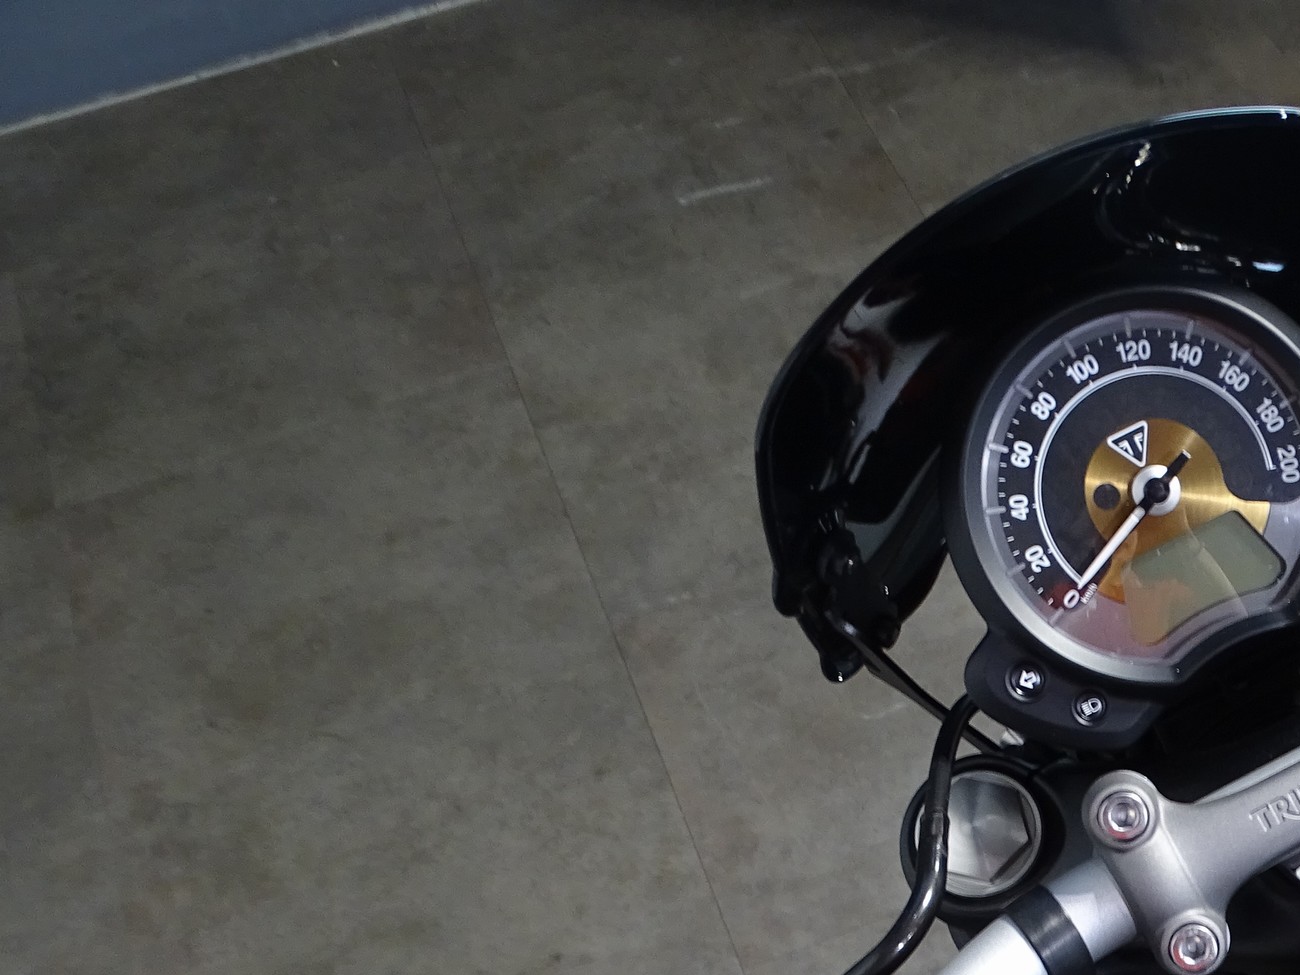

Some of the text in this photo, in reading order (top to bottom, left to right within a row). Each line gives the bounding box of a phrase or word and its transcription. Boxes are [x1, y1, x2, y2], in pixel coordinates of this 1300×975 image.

[1116, 339, 1151, 363] 120
[1169, 341, 1203, 367] 140
[1066, 354, 1100, 384] 100
[1217, 360, 1250, 392] 160
[1030, 391, 1057, 421] 80
[1255, 396, 1285, 434] 180
[1010, 440, 1034, 469] 60
[1276, 443, 1300, 484] 200
[1008, 494, 1030, 522] 40
[1024, 544, 1052, 574] 20
[1062, 587, 1081, 610] 0
